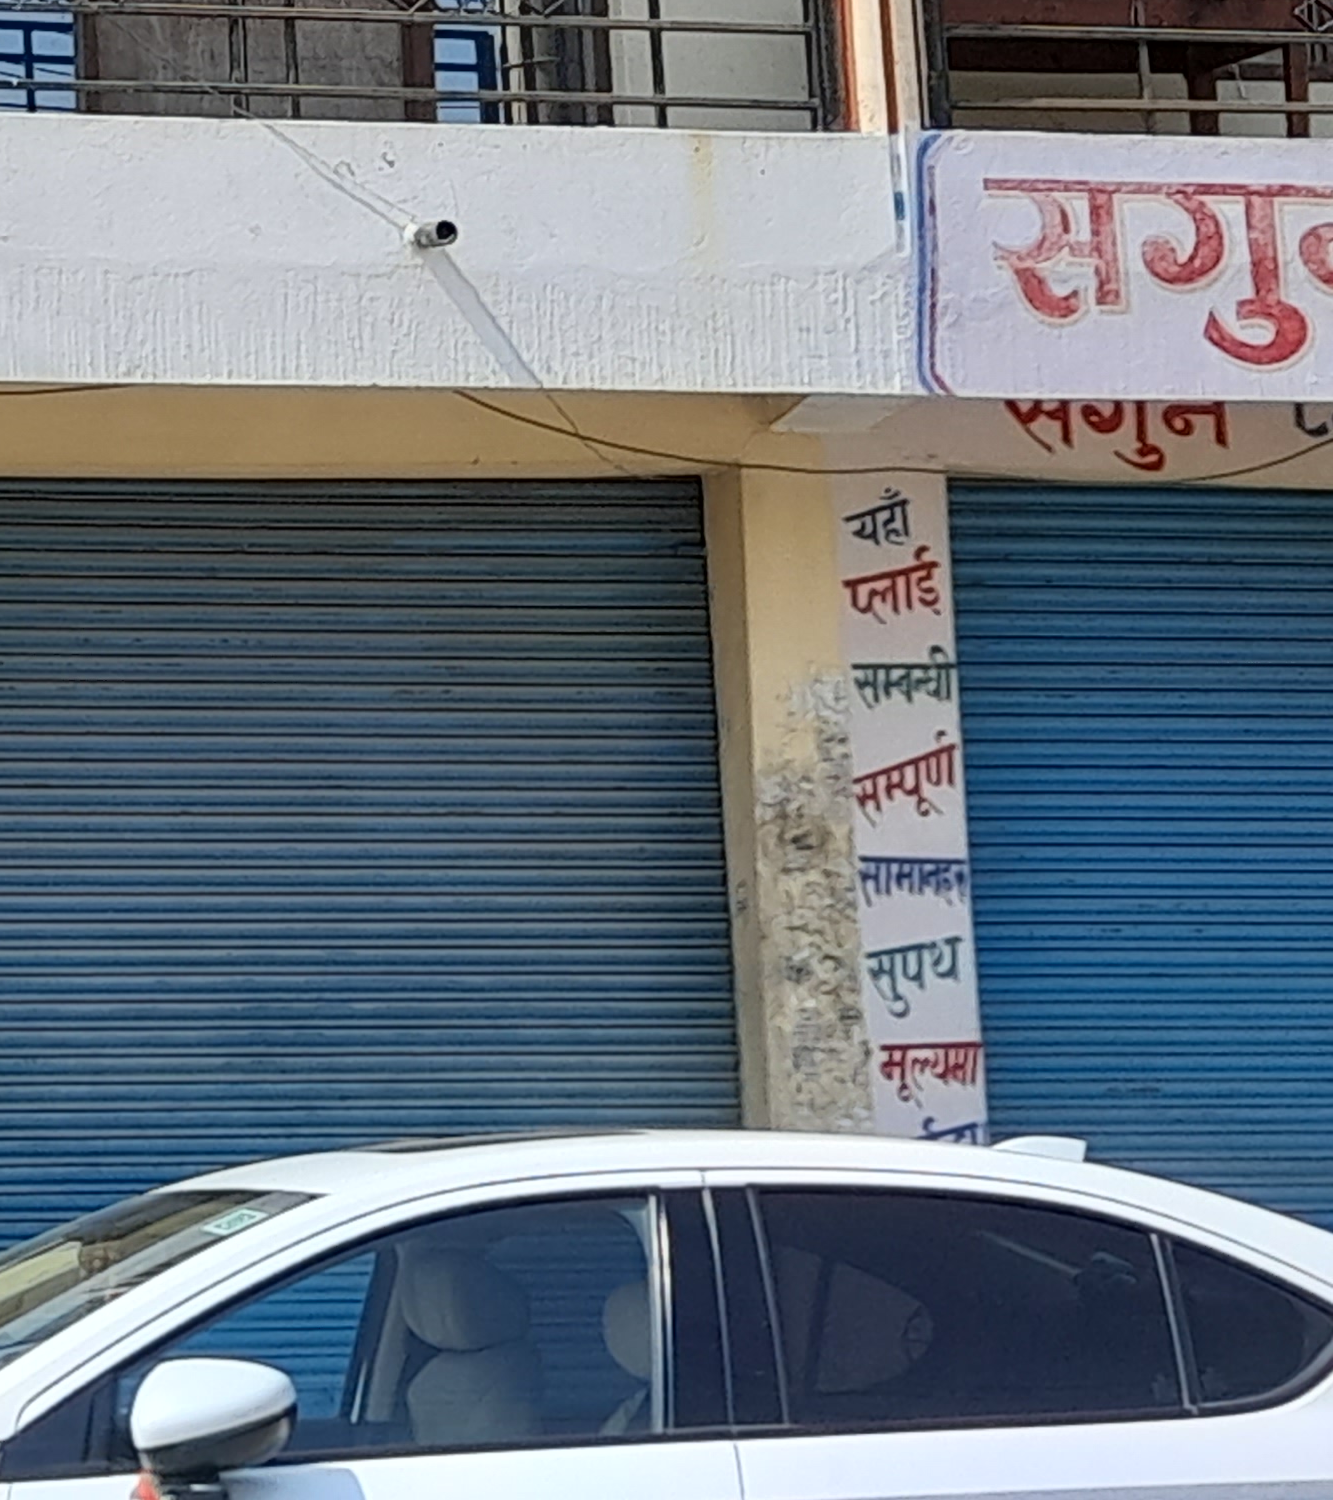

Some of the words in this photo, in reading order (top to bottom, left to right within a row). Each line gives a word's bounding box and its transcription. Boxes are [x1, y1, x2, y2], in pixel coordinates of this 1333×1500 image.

[841, 545, 942, 625] प्लाई
[852, 730, 957, 828] सम्पूर्ण
[865, 936, 963, 1019] सुपथ
[879, 1041, 983, 1109] मूल्यमा
